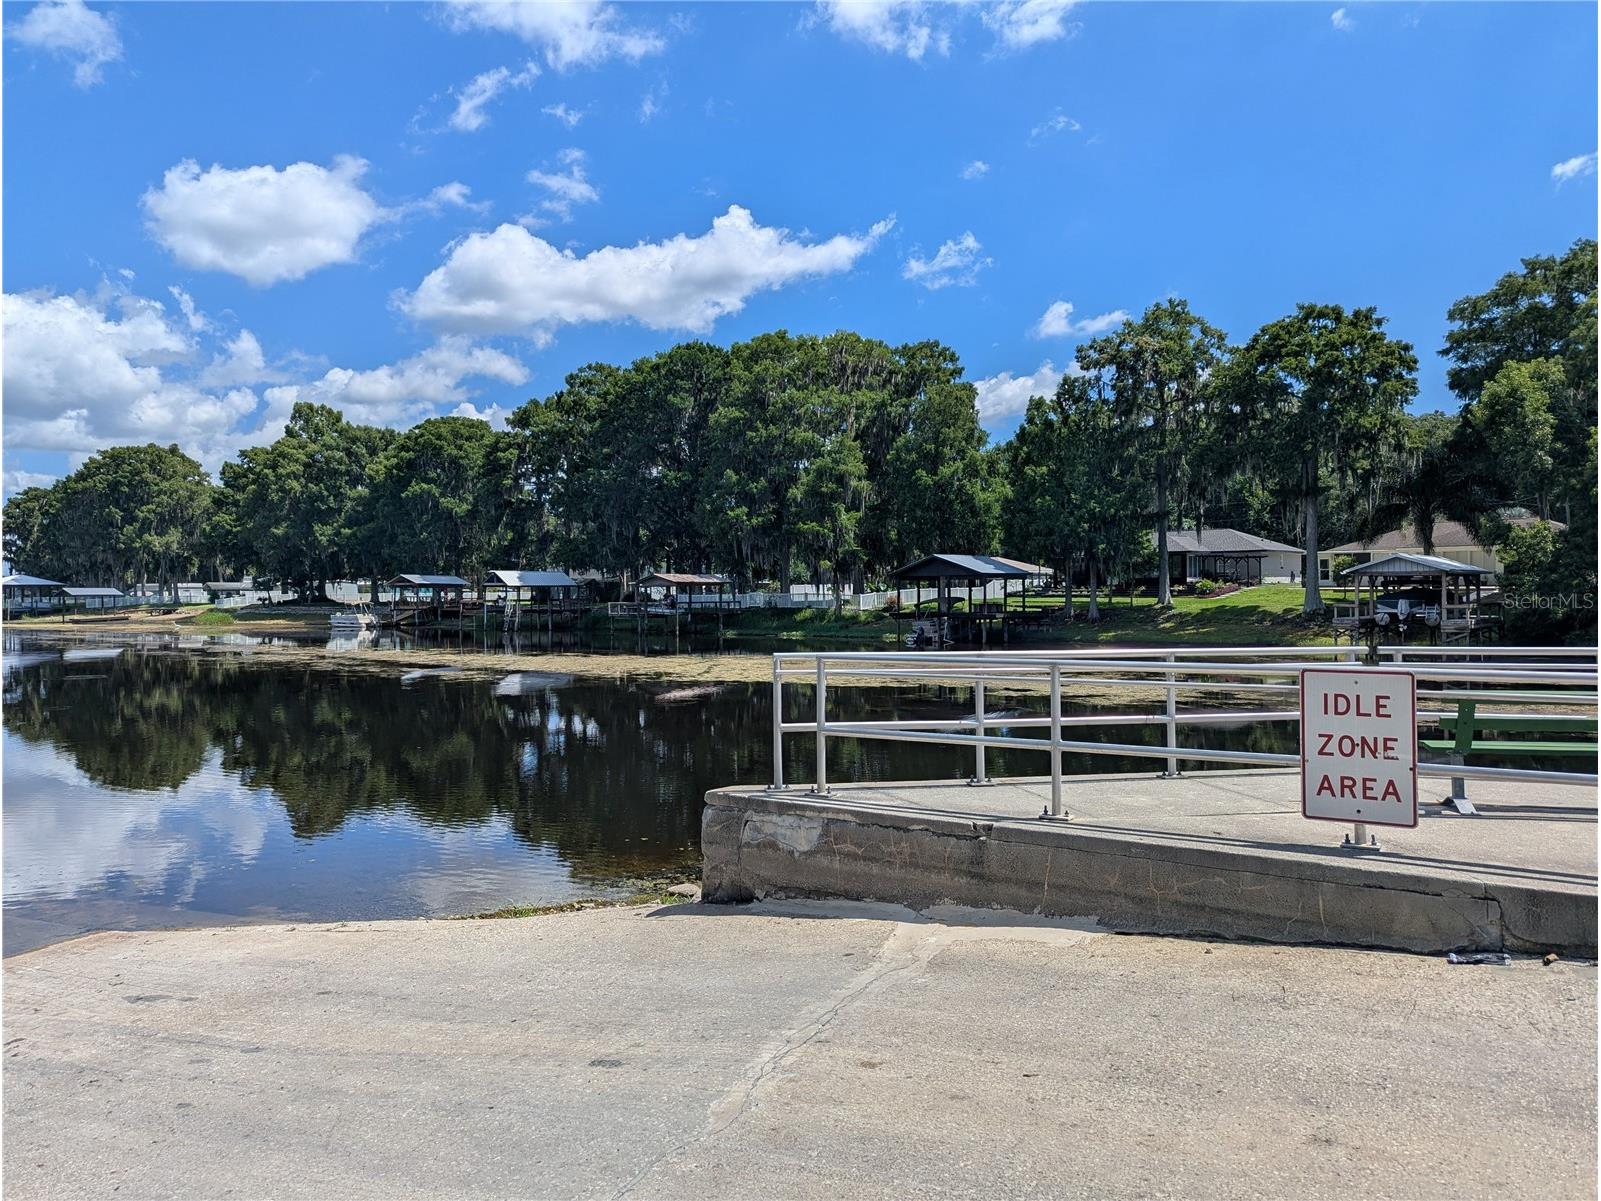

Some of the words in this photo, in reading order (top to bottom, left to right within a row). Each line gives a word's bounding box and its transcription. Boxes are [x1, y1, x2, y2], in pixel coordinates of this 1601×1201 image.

[1323, 692, 1392, 719] IDLE
[1317, 733, 1399, 761] ZONE
[1316, 774, 1402, 803] AREA
